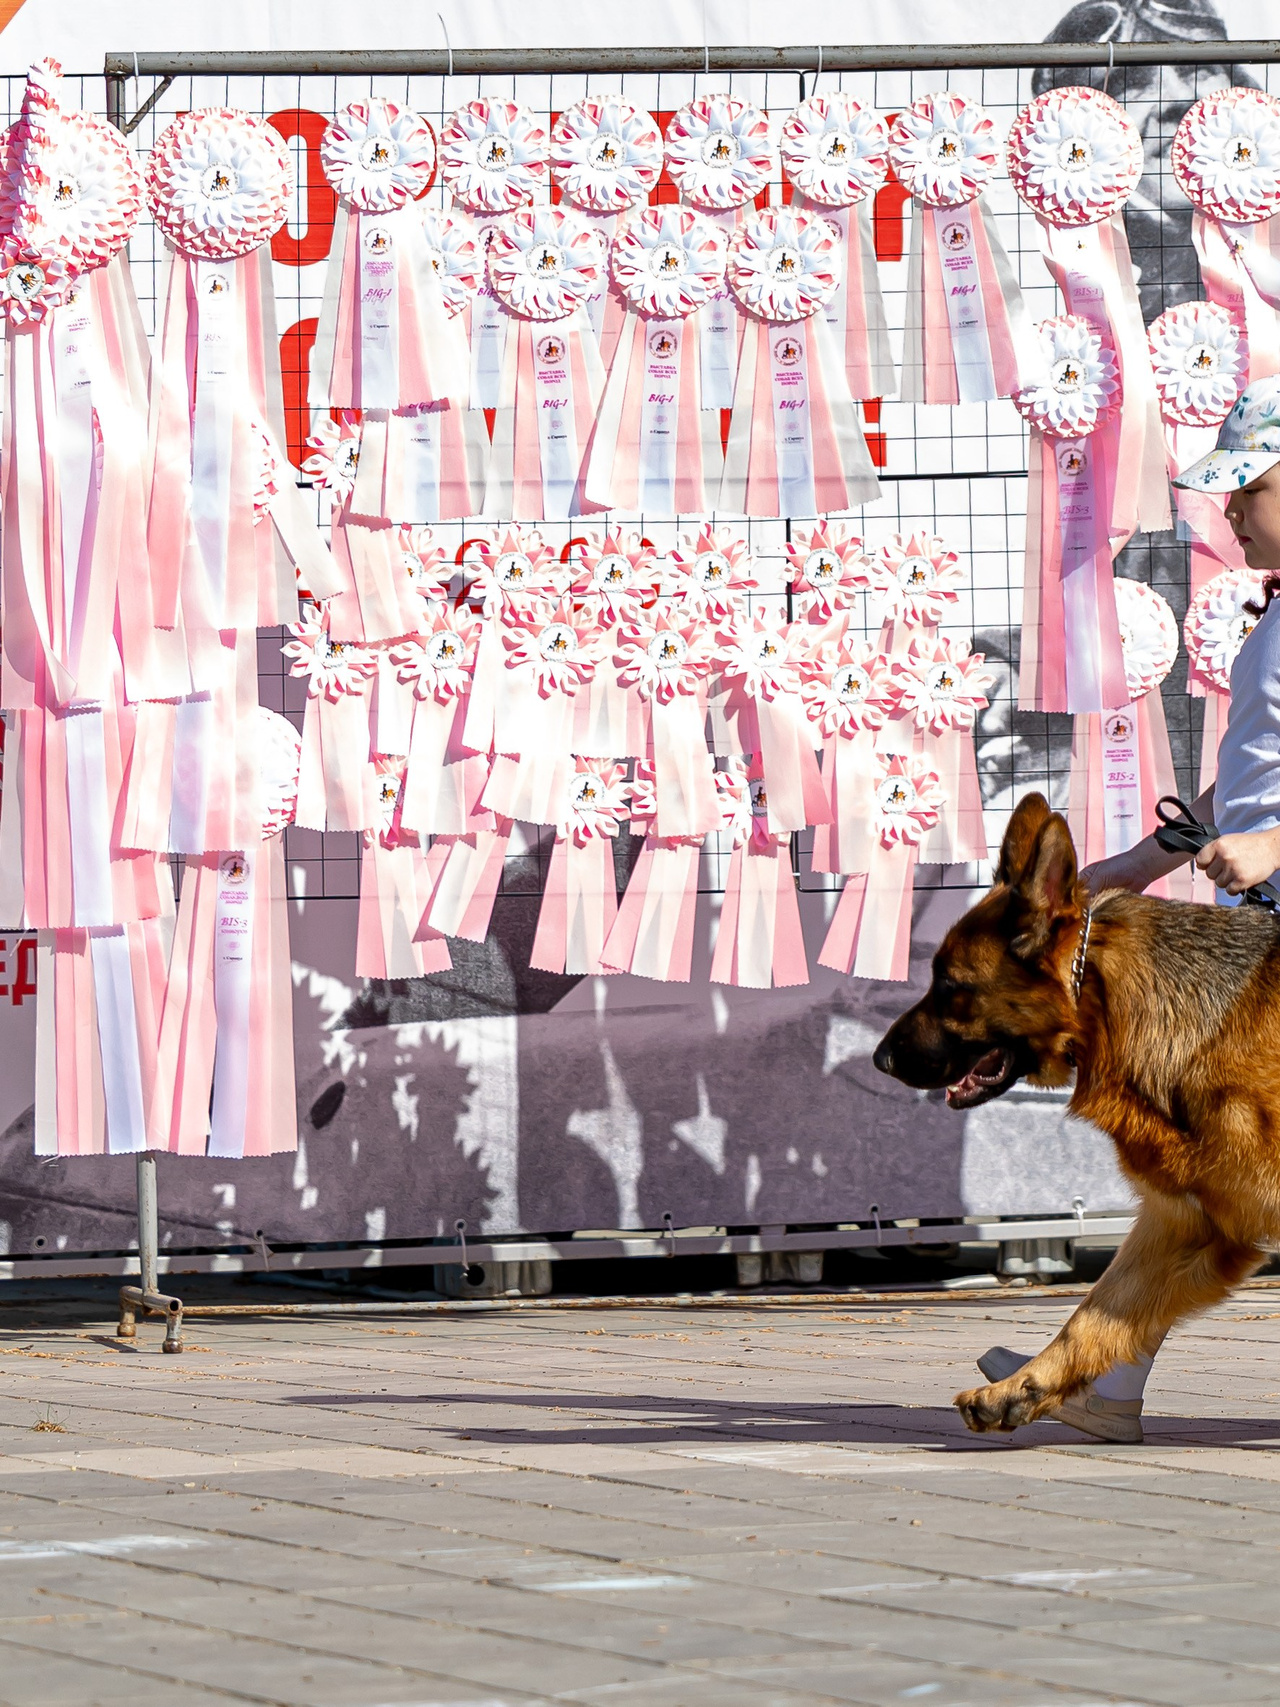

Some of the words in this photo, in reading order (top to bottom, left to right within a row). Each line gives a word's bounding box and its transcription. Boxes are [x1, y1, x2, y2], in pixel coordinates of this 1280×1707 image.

[366, 288, 392, 298] BIG-1
[950, 284, 976, 297] BIG-1
[542, 399, 568, 410] BIG-1
[648, 394, 674, 405] BIG-1
[780, 399, 805, 410] BIG-1
[1064, 504, 1090, 514] BIS-3
[1108, 772, 1135, 781] BIS-2
[220, 917, 248, 928] BIS-3
